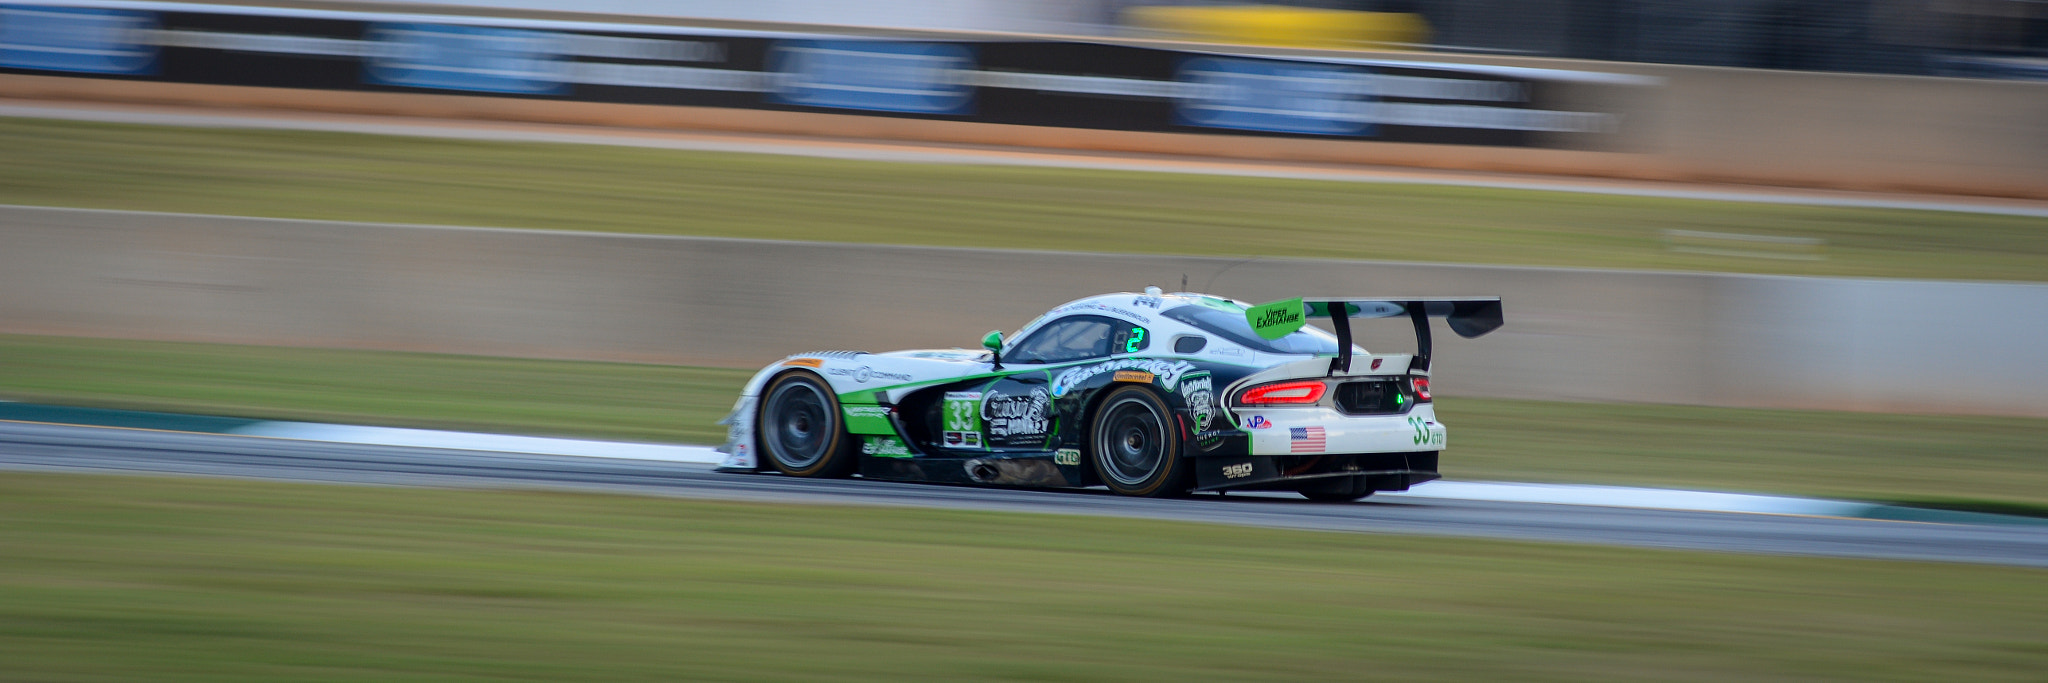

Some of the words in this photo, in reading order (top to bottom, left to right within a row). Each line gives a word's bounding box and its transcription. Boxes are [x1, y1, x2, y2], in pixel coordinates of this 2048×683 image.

[1126, 327, 1144, 353] 2
[949, 400, 974, 431] 33
[1408, 416, 1430, 446] 33
[1056, 451, 1080, 463] GTD
[1222, 462, 1253, 476] 360
